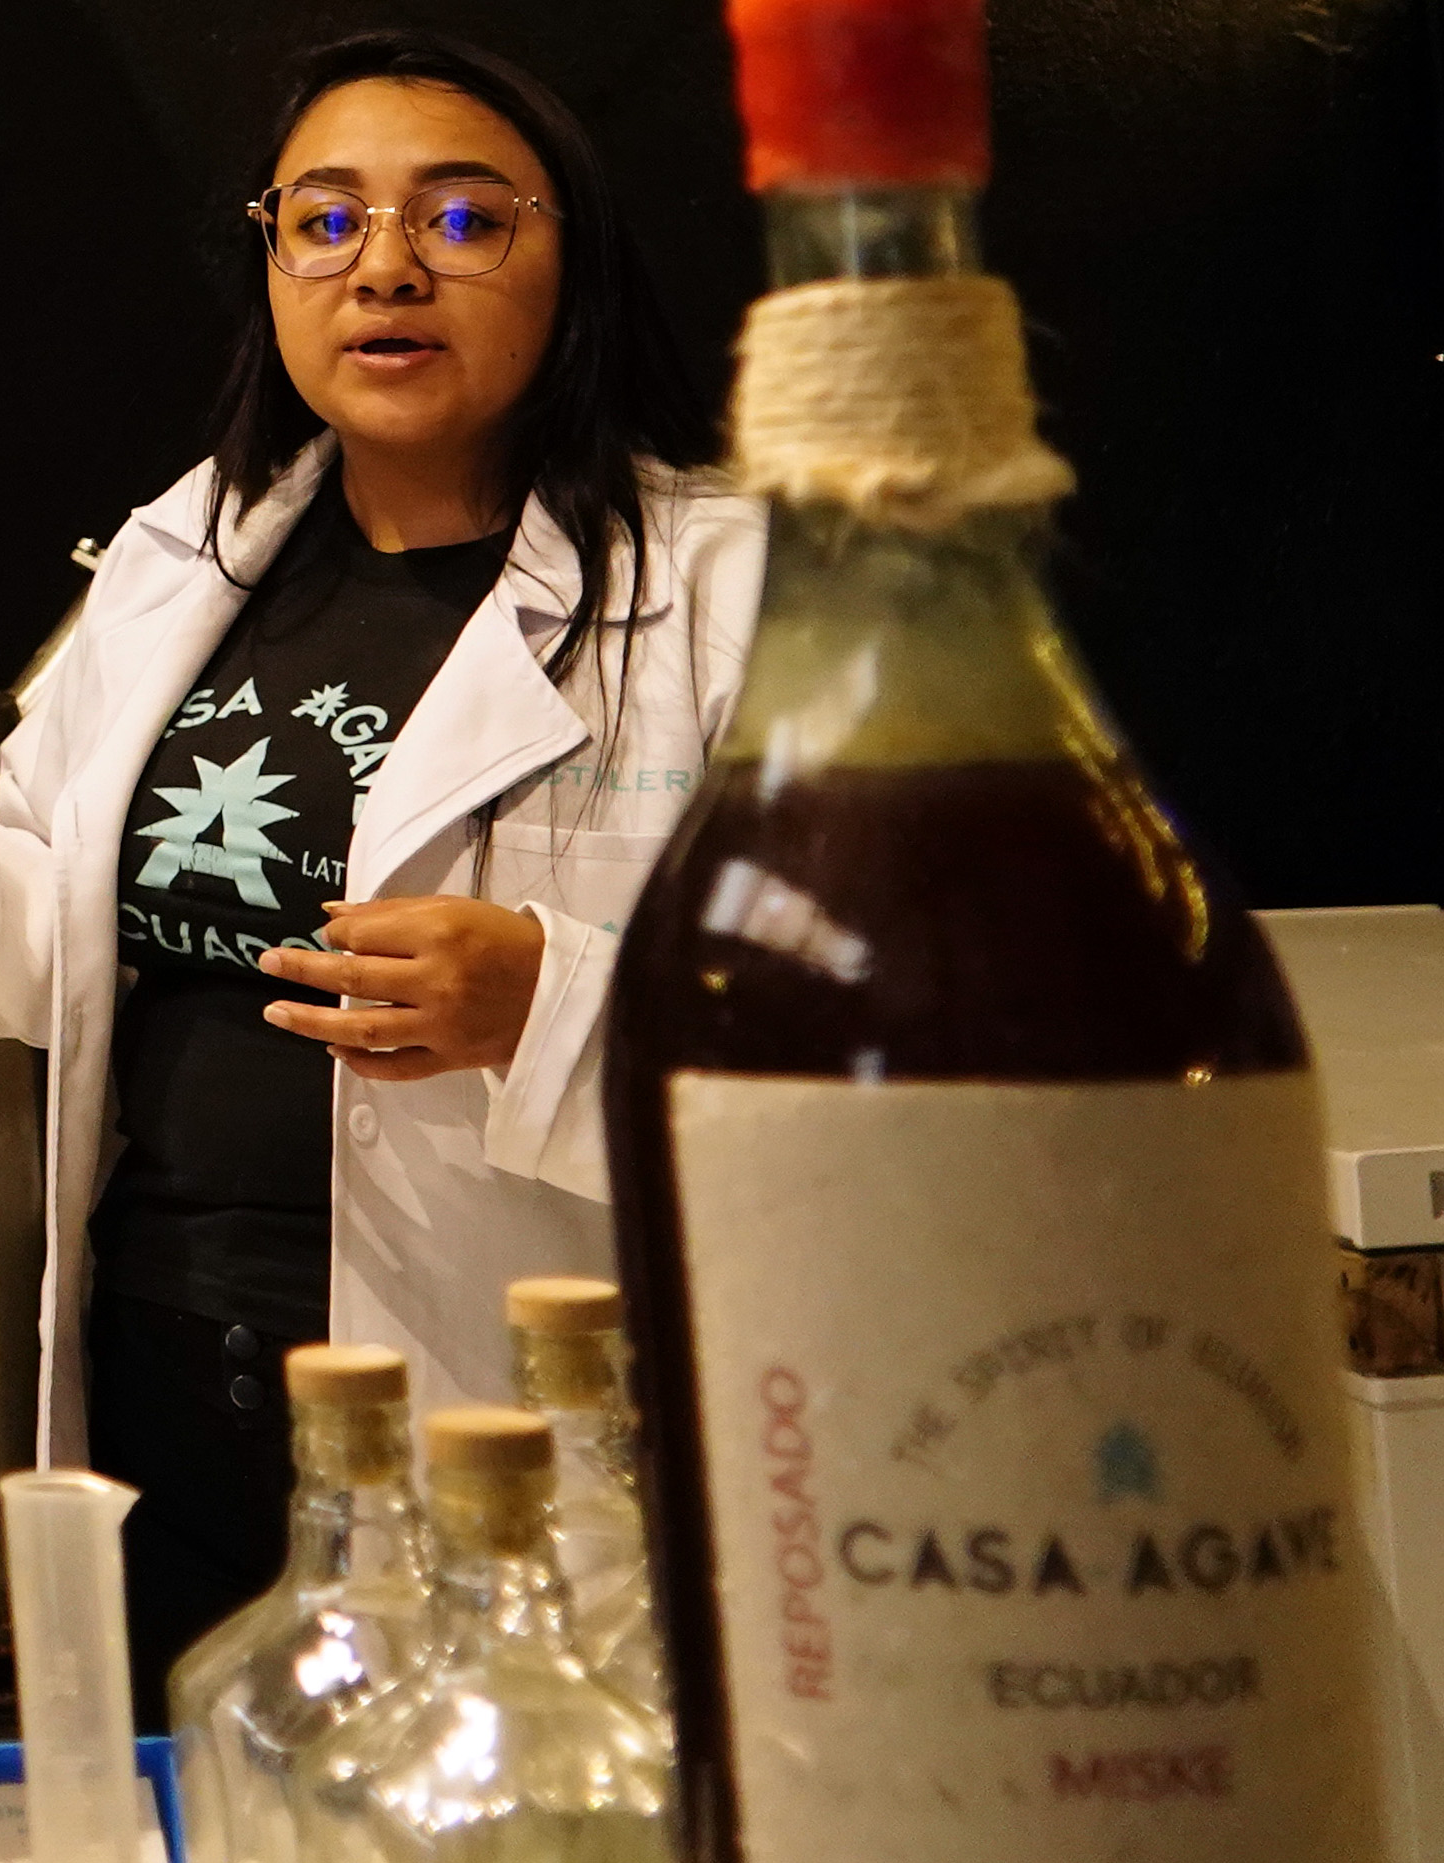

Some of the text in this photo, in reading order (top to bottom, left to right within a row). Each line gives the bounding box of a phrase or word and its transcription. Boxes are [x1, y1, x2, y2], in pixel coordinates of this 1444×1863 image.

[759, 1365, 833, 1703] REPOSADO
[837, 1503, 1341, 1598] CASA AGAVE
[986, 1654, 1262, 1710] ECUADOR
